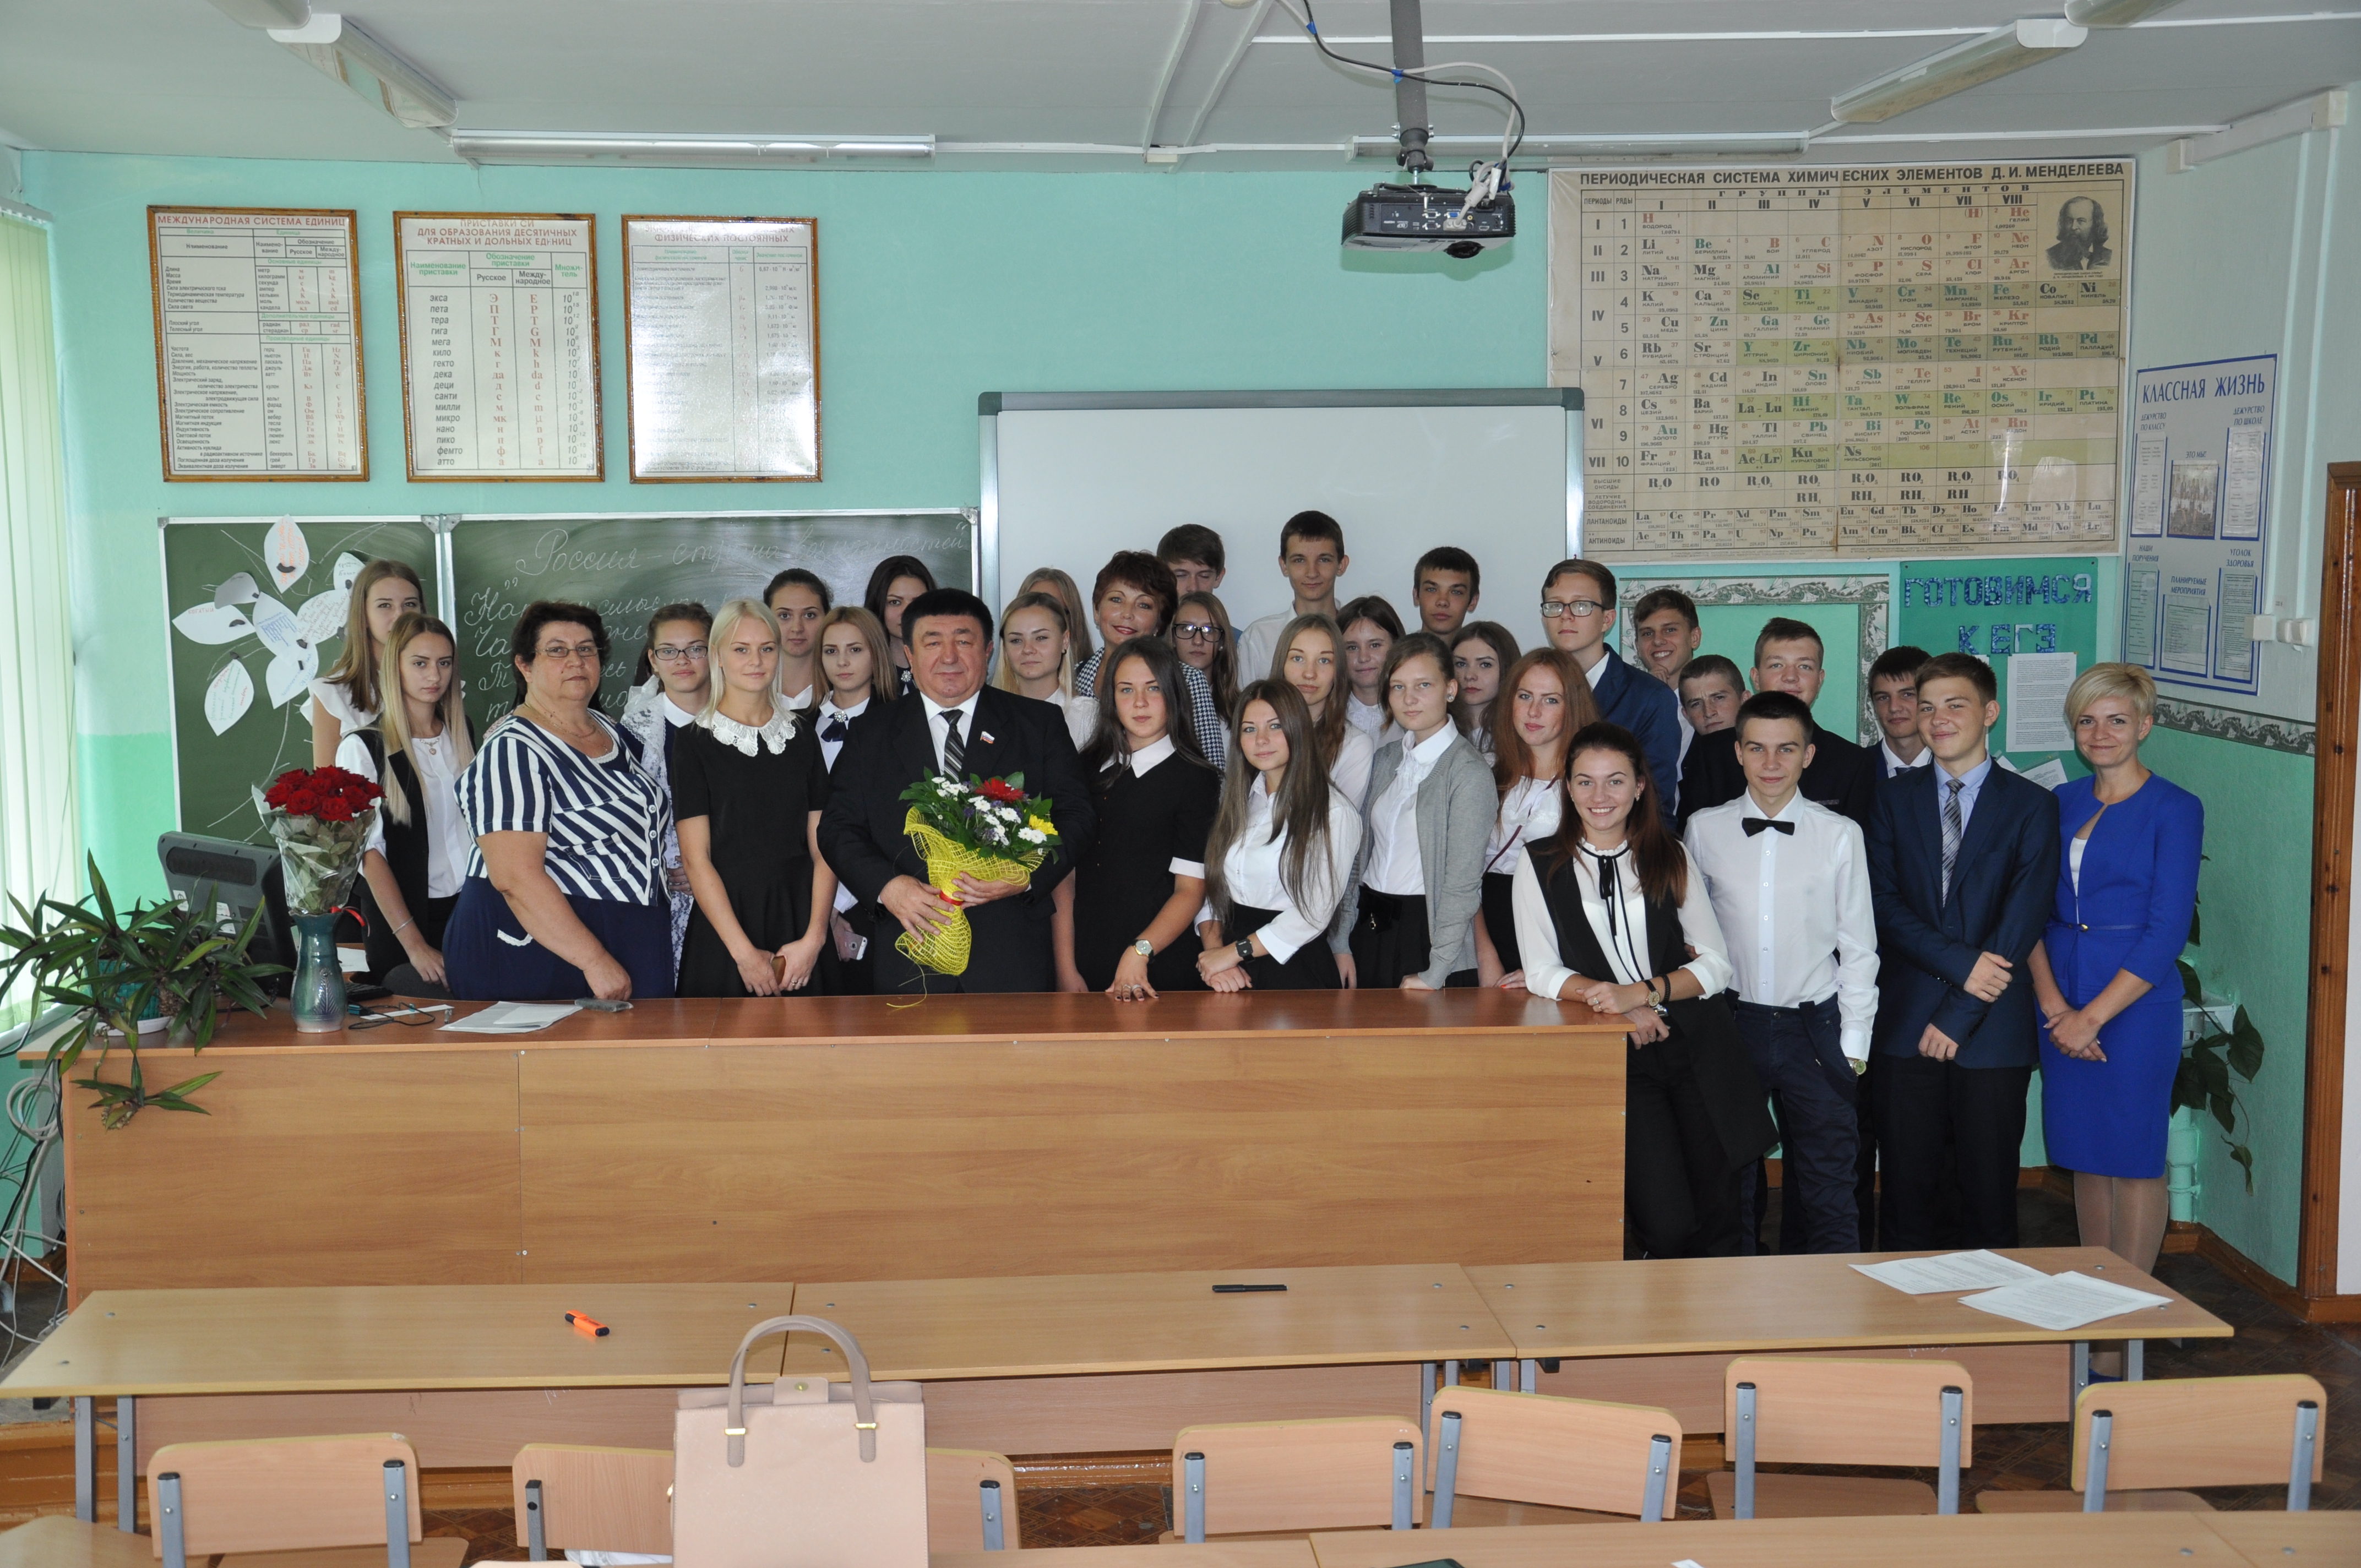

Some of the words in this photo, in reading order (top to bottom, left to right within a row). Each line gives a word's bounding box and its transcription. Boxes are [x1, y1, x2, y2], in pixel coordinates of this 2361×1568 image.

[1580, 173, 1705, 186] ПЕРИОДИЧЕСКАЯ
[1713, 172, 1780, 184] СИСТЕМА
[1788, 170, 1889, 182] ХИМИЧЕСКИХ
[1896, 168, 1982, 180] ЭЛЕМЕНТОВ
[1992, 167, 2005, 180] Д.
[2009, 167, 2021, 177] И.
[2026, 164, 2123, 178] МЕНДЕЛЕЕВА
[1759, 200, 1770, 209] III
[1809, 199, 1820, 208] IV
[1909, 197, 1920, 206] VI
[1957, 196, 1972, 205] VII
[2003, 195, 2022, 204] VIII
[2010, 207, 2029, 217] He
[158, 216, 250, 225] МЕЖДУНАРОДНАЯ
[485, 237, 532, 246] ДОЛЬНЫХ
[2011, 232, 2029, 242] Ne
[1642, 239, 1655, 249] Li
[1695, 238, 1711, 249] Be
[2010, 258, 2029, 268] Ar
[1641, 265, 1660, 275] Na
[1694, 265, 1716, 276] Mg
[1993, 284, 2009, 295] Fe
[2081, 282, 2096, 292] Ni
[1695, 290, 1711, 301] Ca
[1710, 316, 1728, 326] Zn
[1658, 373, 1678, 385] Ag
[2143, 379, 2205, 403] КЛАССНАЯ
[2215, 373, 2265, 397] ЖИЗНЬ
[2233, 406, 2265, 415] ДЕЖУРСТВО
[2141, 412, 2166, 421] ДЕЖУРСТВО
[1657, 425, 1678, 434] Au
[437, 447, 463, 456] фемто
[1589, 458, 1605, 467] VII
[1616, 456, 1629, 467] 10
[515, 529, 641, 576] Россия
[2171, 576, 2206, 585] ПЛАНИРУЕМЫЕ
[1905, 574, 2092, 608] ГОТОВИМСЯ
[2171, 587, 2206, 595] МЕРОПРИЯТИЯ
[1959, 625, 1979, 654] К
[1991, 624, 2055, 654] ЕГЭ
